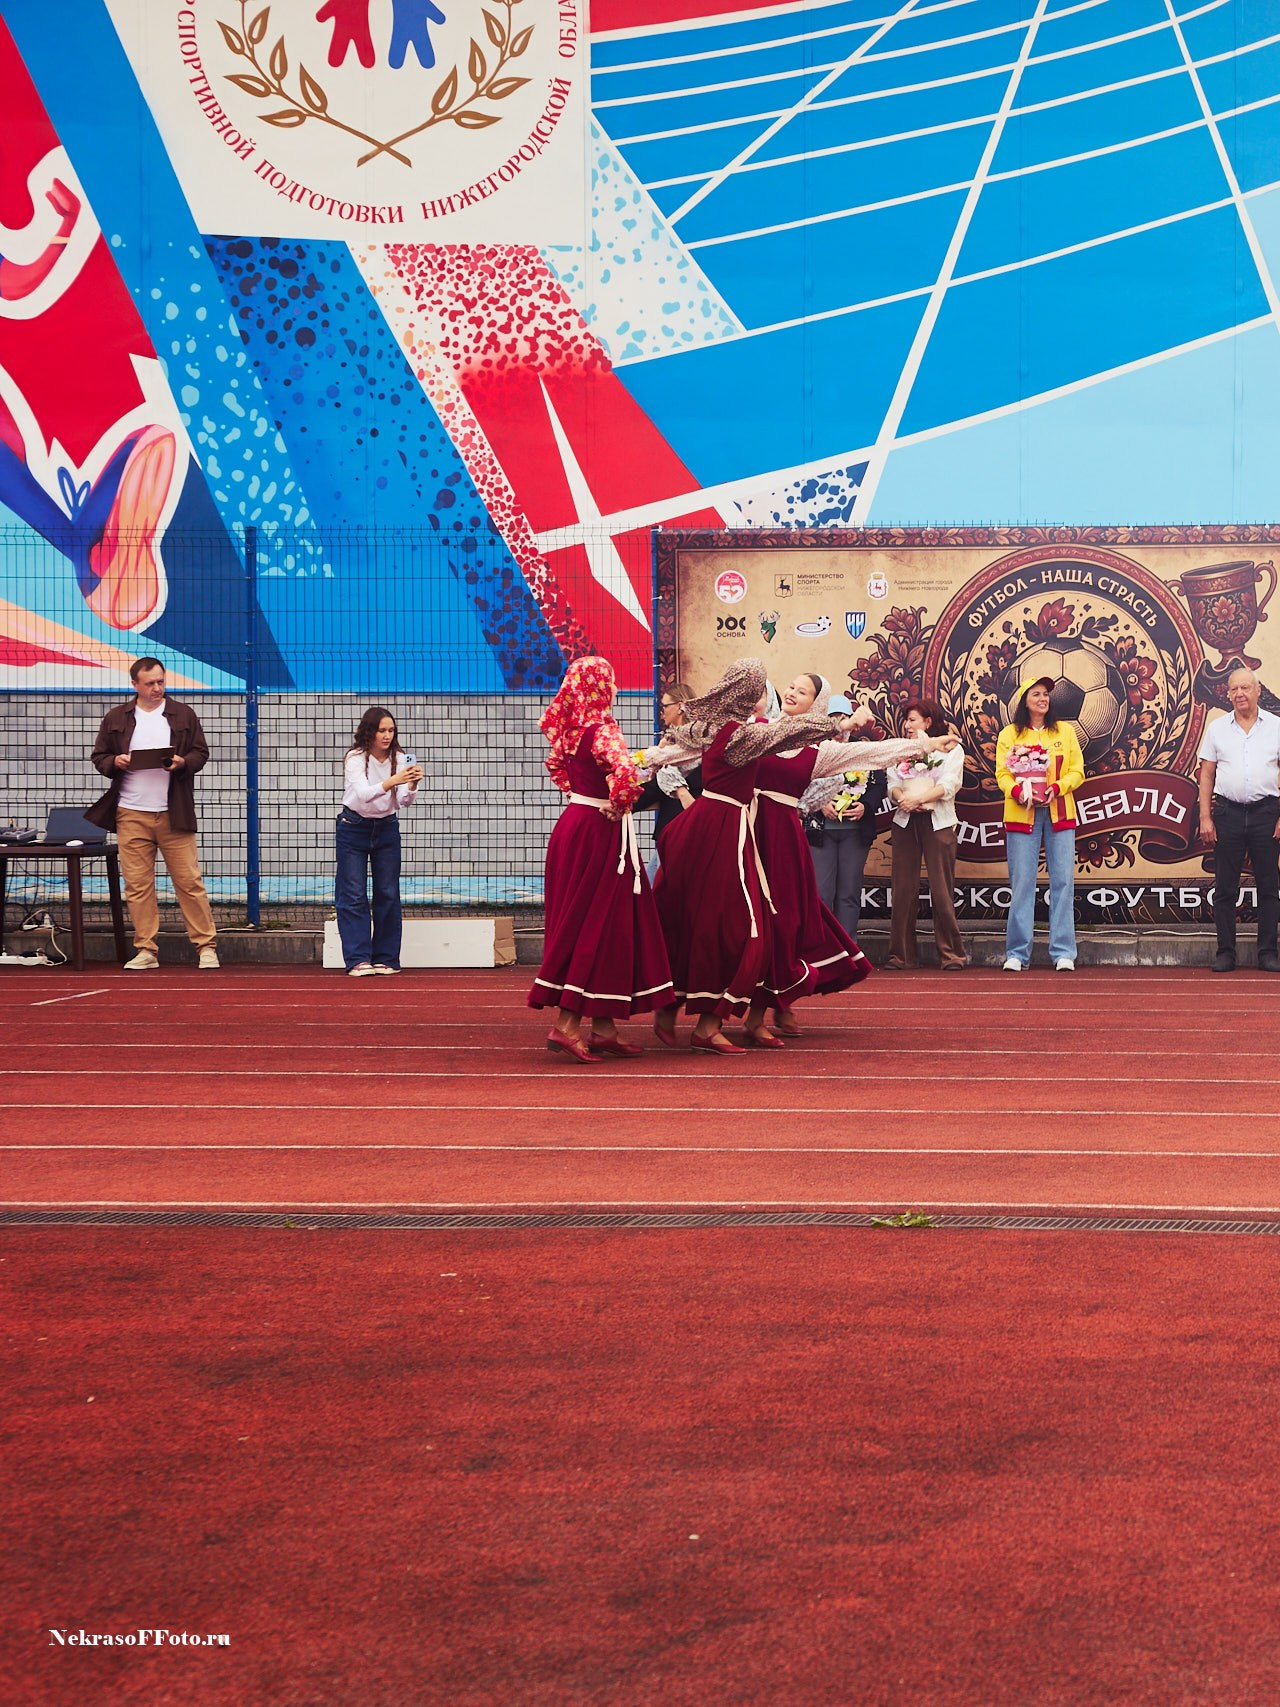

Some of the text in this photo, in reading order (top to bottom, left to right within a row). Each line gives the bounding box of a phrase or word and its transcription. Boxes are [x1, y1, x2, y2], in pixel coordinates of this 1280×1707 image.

[177, 10, 257, 161] СПОРТИВНОЙ
[253, 158, 404, 224] ПОДГОТОВКИ
[420, 77, 572, 219] НИЖЕГОРОДСКОЙ
[719, 585, 745, 602] 52
[968, 577, 1028, 629] ФУТБОЛ
[1041, 569, 1094, 585] НАША
[1097, 576, 1159, 628] СТРАСТЬ
